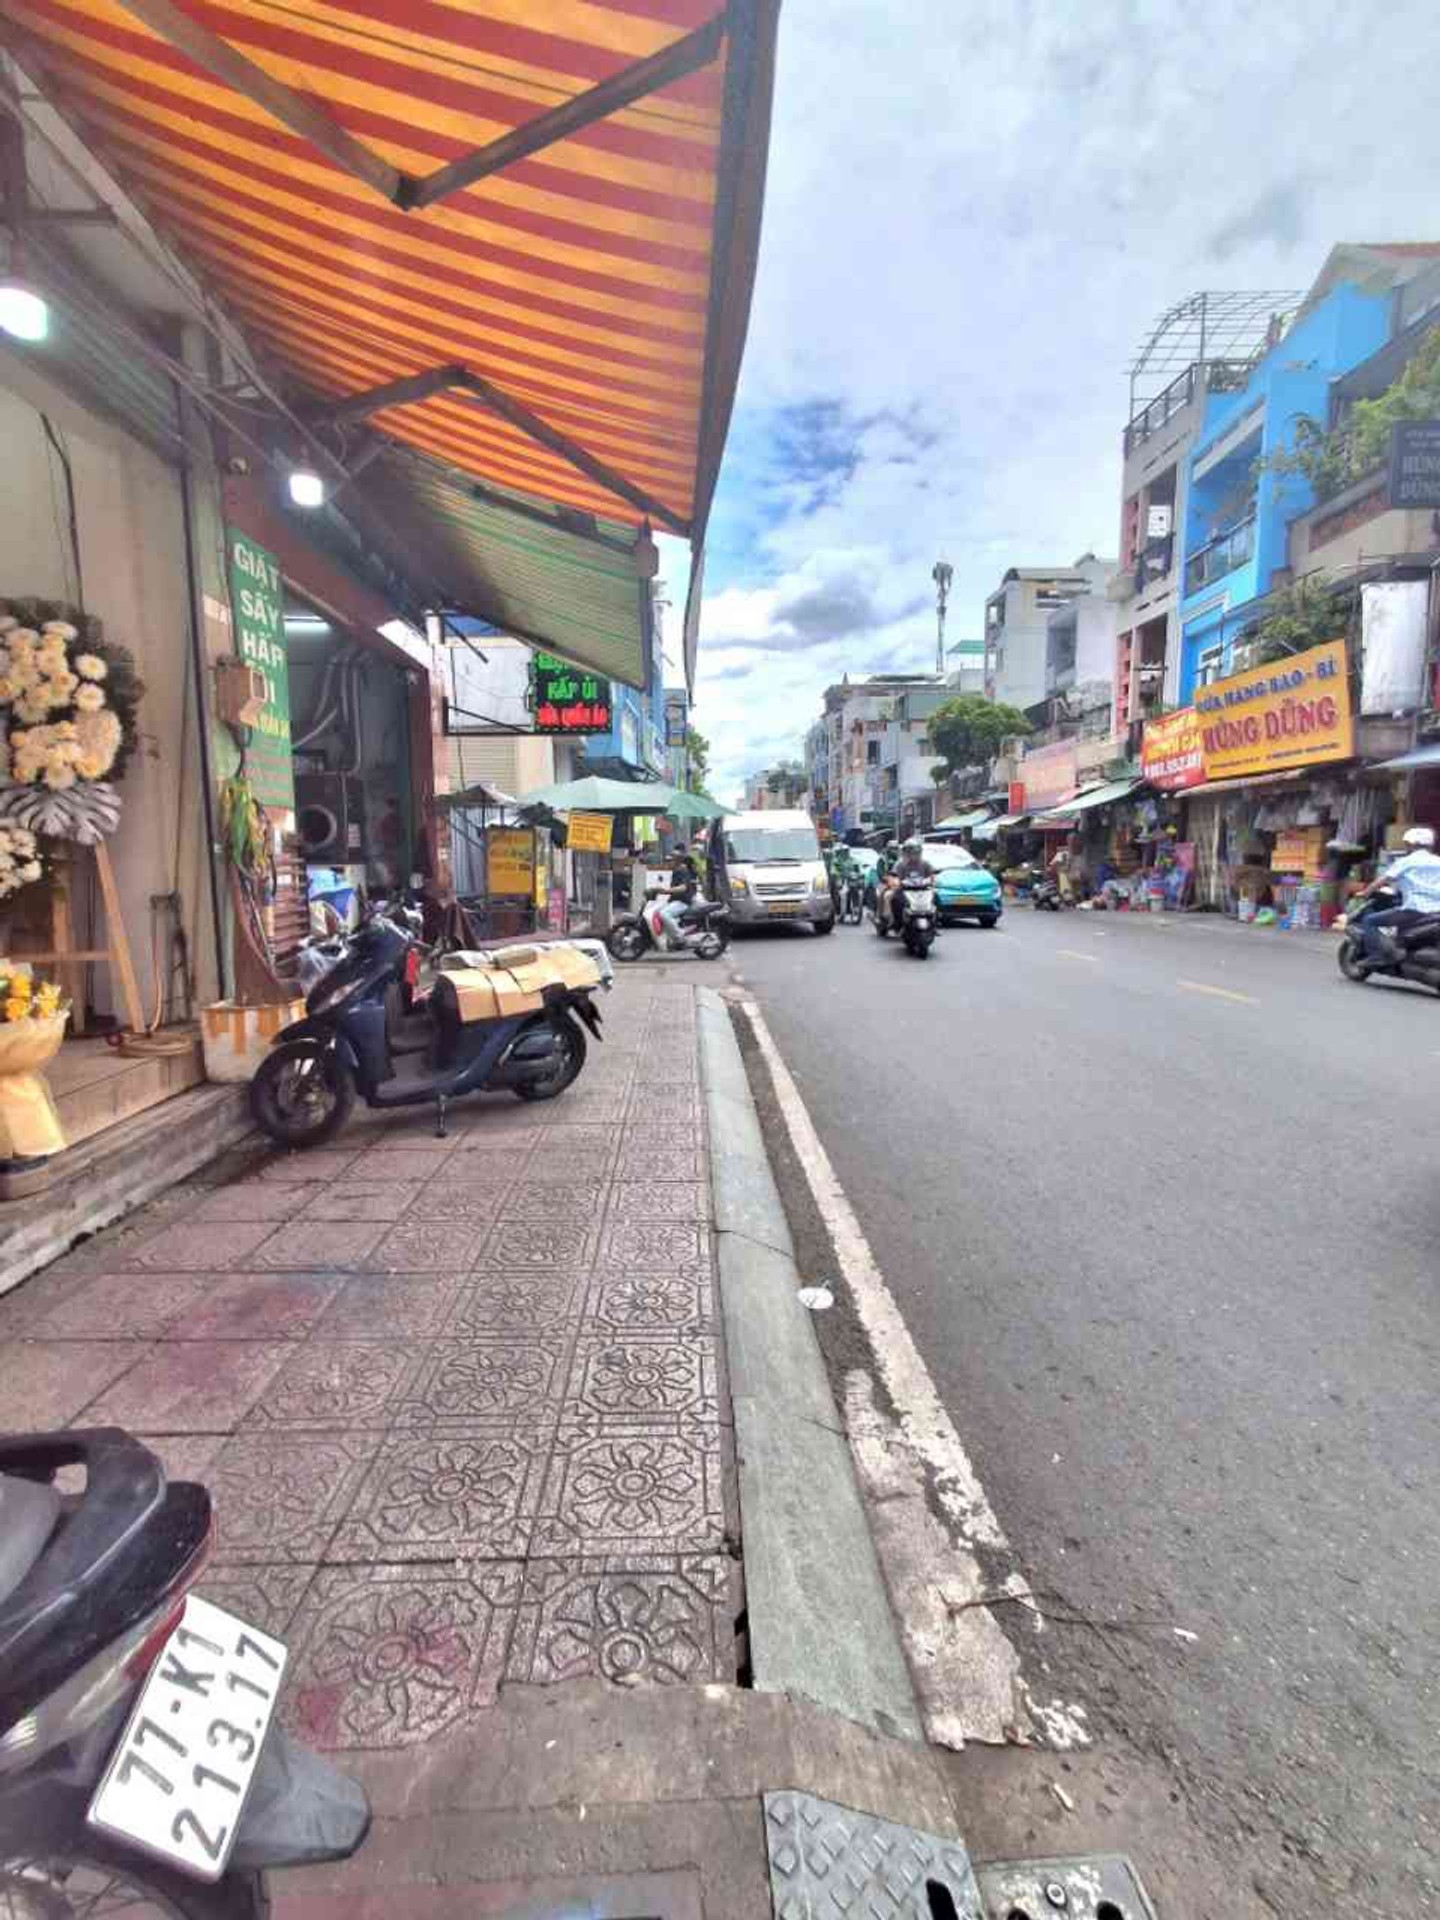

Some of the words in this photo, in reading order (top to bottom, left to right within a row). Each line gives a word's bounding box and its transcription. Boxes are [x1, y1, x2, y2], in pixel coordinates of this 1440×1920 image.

[239, 589, 280, 630] SẤY
[1263, 696, 1336, 740] DŨNG
[116, 1627, 225, 1796] 77-K1
[171, 1633, 280, 1861] 213.17
